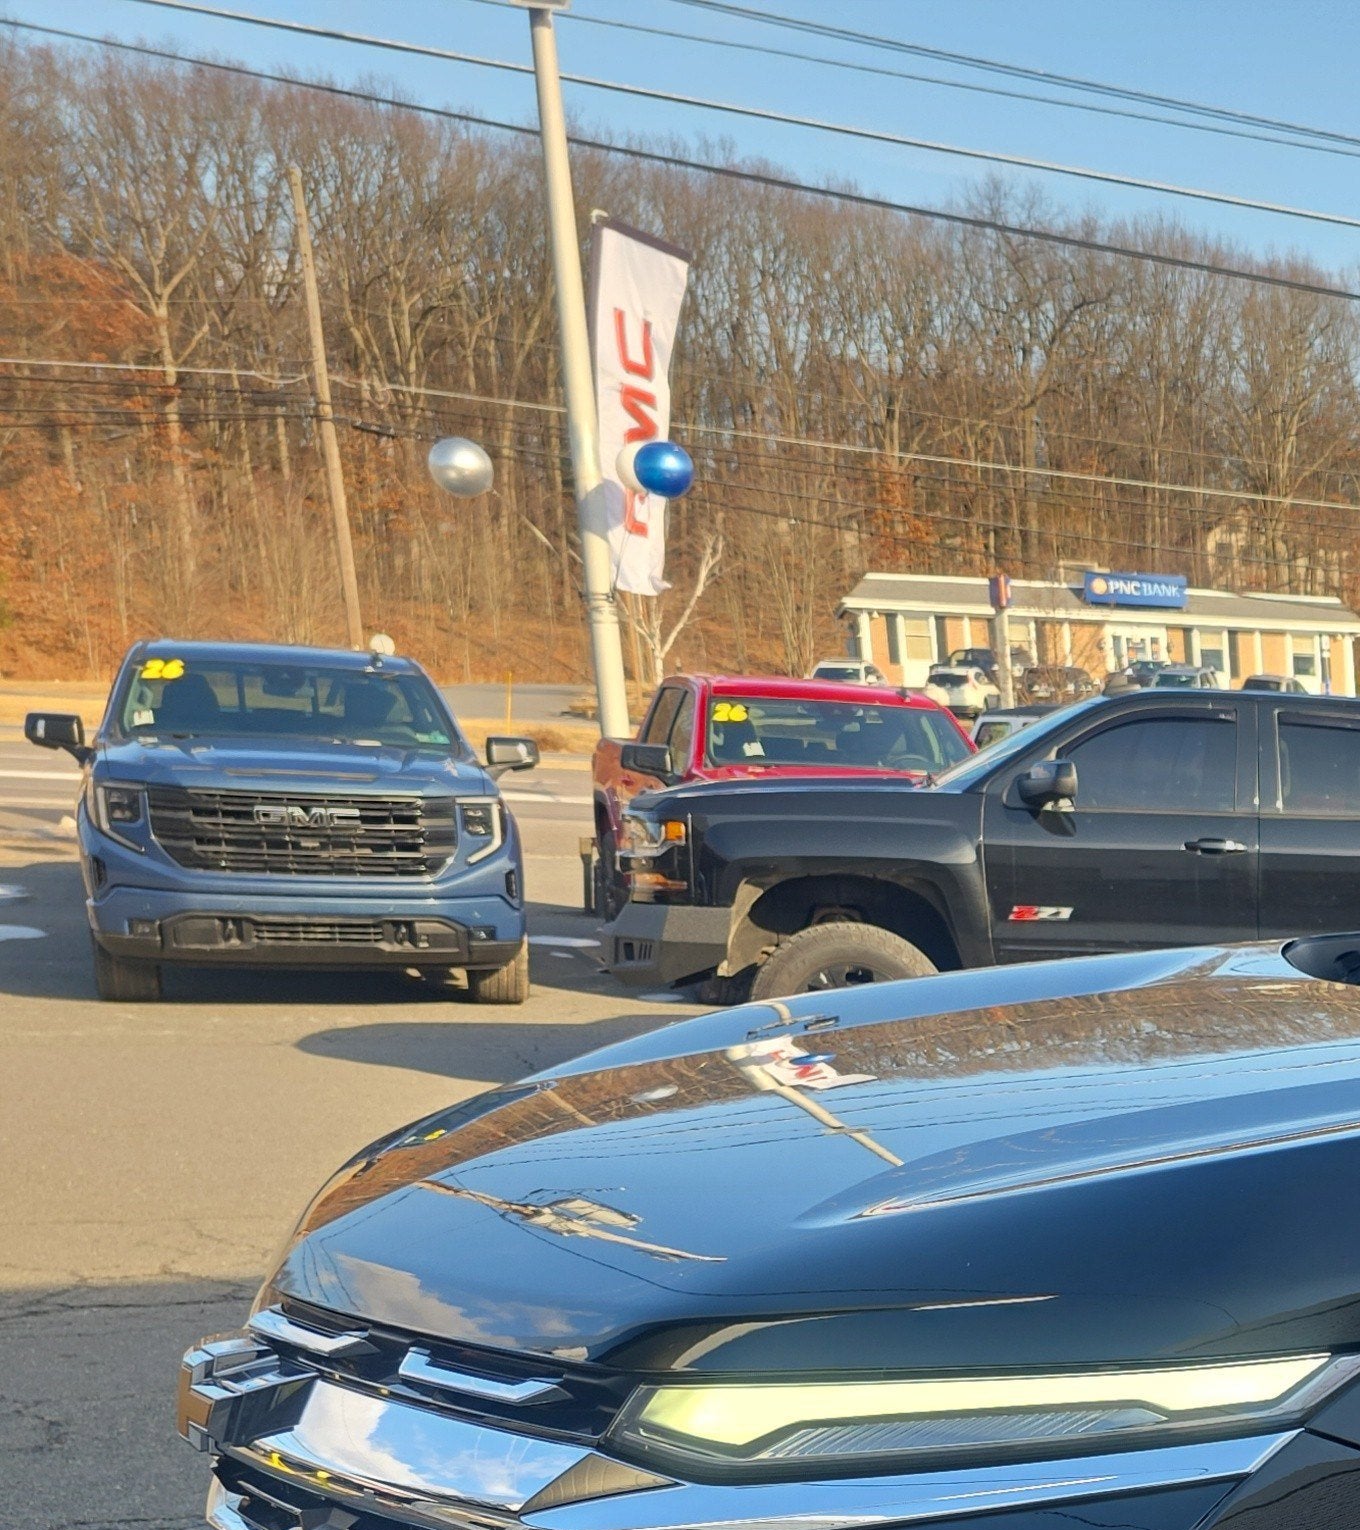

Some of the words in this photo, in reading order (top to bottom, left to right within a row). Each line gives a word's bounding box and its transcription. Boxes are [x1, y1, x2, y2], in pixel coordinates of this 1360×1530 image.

[1109, 579, 1141, 595] PNC
[1142, 582, 1181, 598] BANK
[141, 658, 184, 679] 26
[712, 702, 748, 722] 26
[254, 805, 360, 827] GMC
[1008, 905, 1074, 921] Z71
